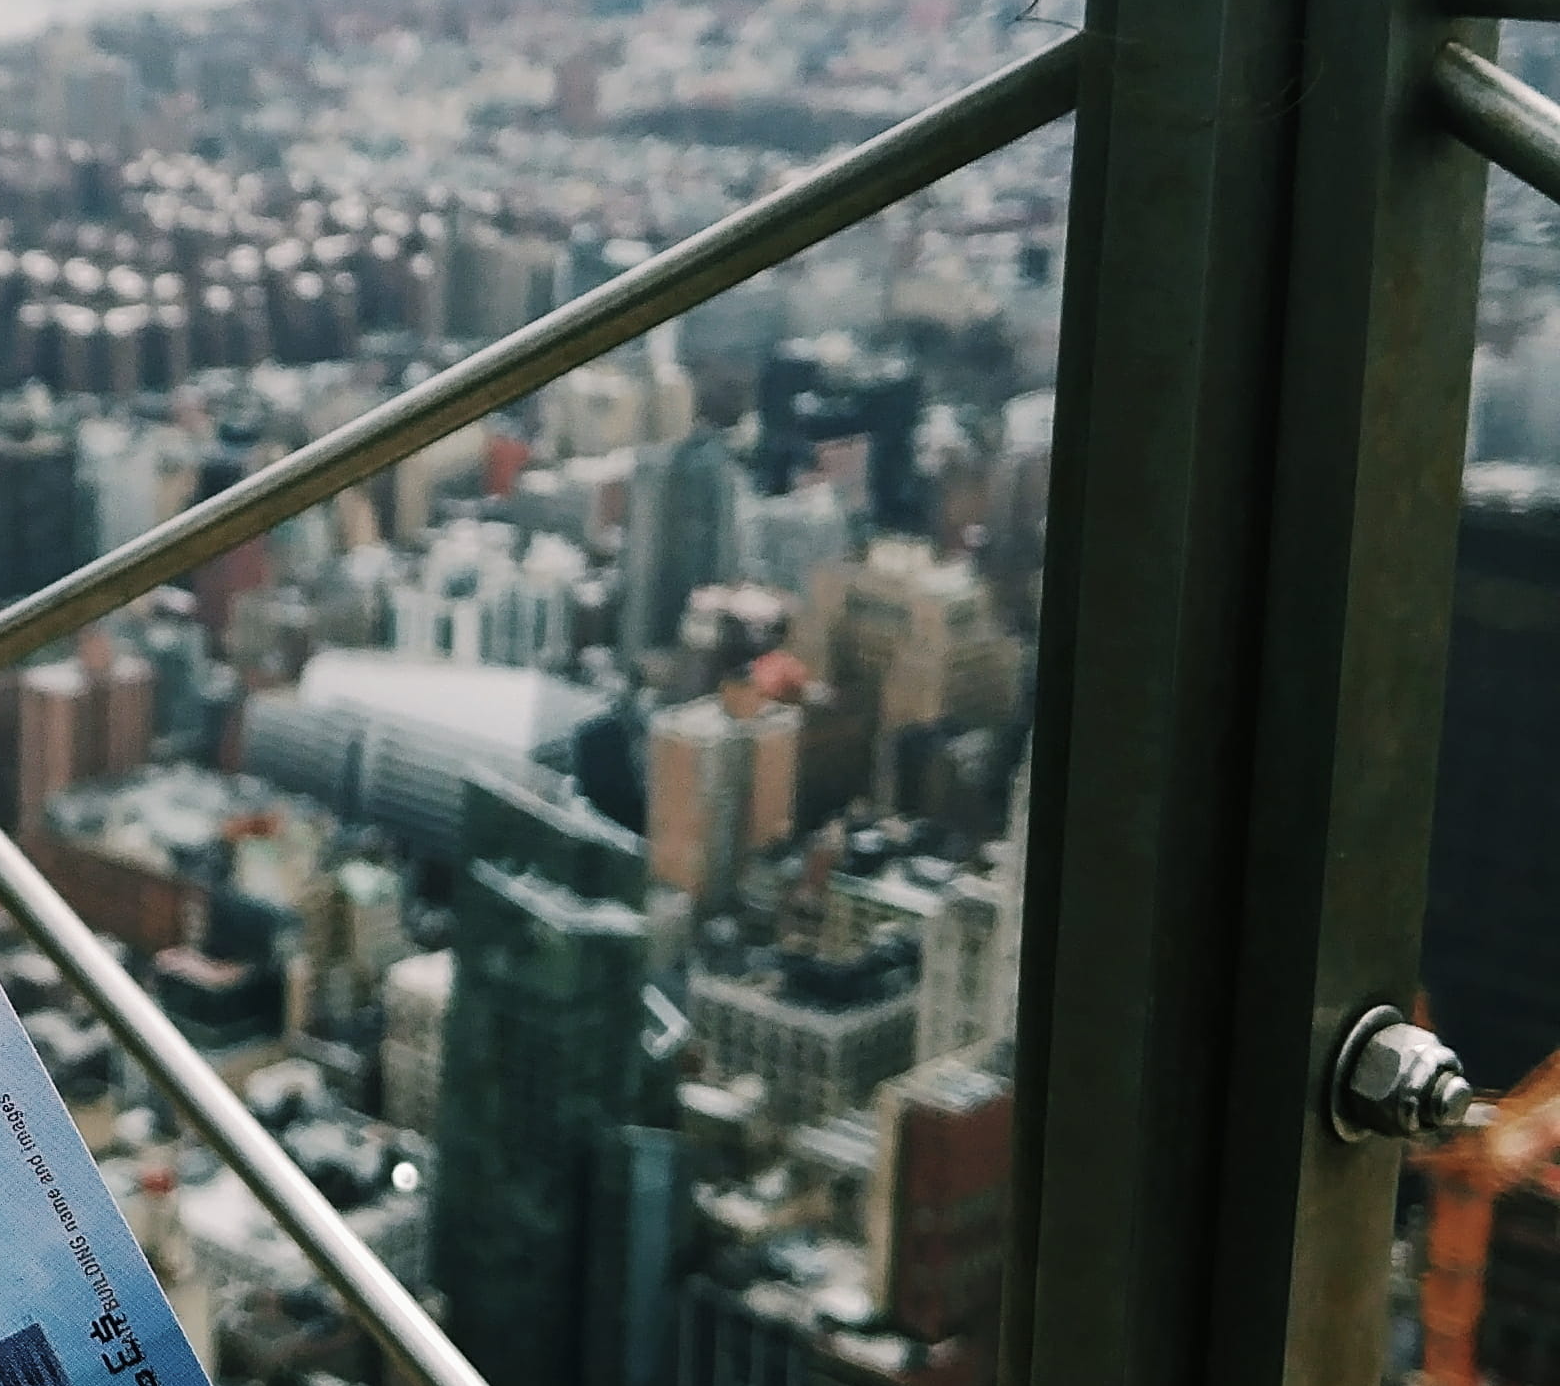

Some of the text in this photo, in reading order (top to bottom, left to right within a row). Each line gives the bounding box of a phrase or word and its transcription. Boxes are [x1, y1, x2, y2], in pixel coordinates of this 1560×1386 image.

[26, 1154, 55, 1186] and
[47, 1188, 78, 1233] name
[69, 1234, 121, 1314] BUILDING
